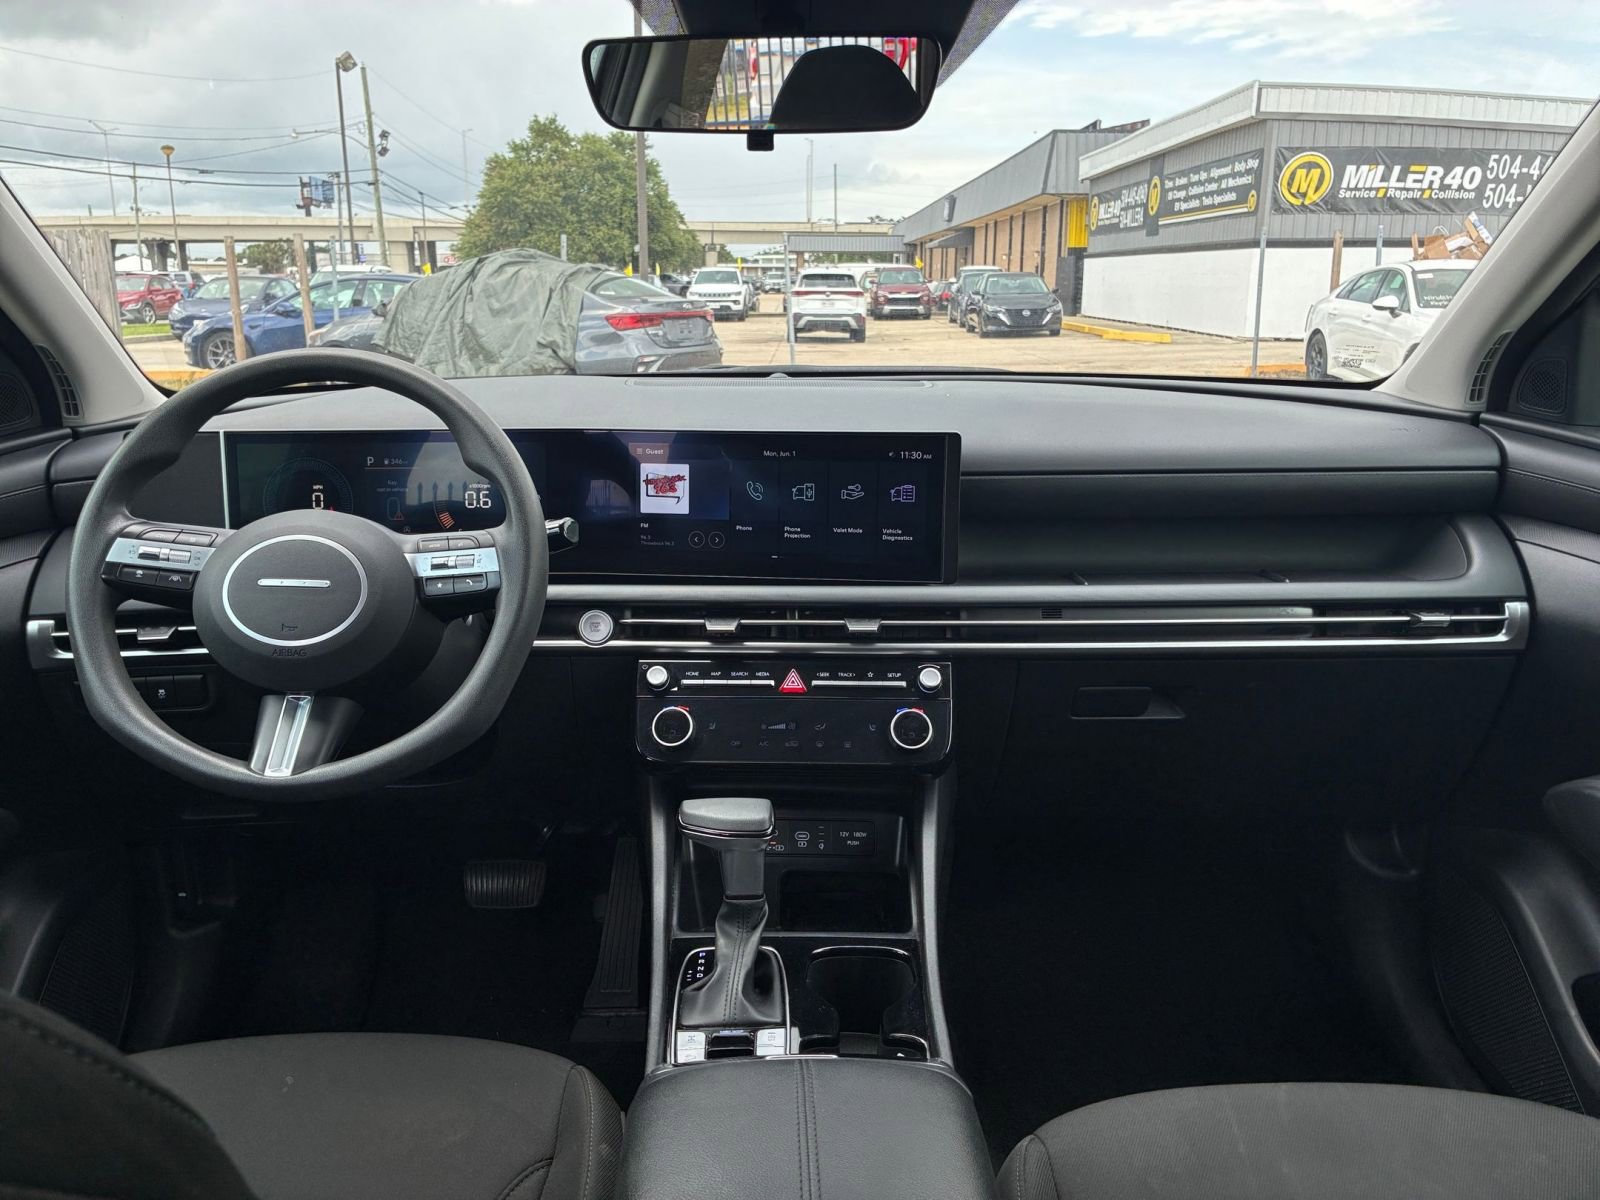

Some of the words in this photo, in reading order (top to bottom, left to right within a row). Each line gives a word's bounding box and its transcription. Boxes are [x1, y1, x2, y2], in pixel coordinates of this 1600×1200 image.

[1443, 165, 1482, 190] 40
[1338, 188, 1376, 198] Service
[1387, 188, 1422, 200] Repair
[1431, 189, 1476, 199] Collision
[1482, 183, 1533, 209] 504-
[763, 450, 779, 458] Mon,
[779, 450, 792, 458] Jun.
[899, 451, 922, 460] 11:30
[367, 456, 375, 466] P
[312, 492, 324, 511] 0
[464, 490, 492, 509] 0.6
[272, 648, 307, 657] AIRBAG
